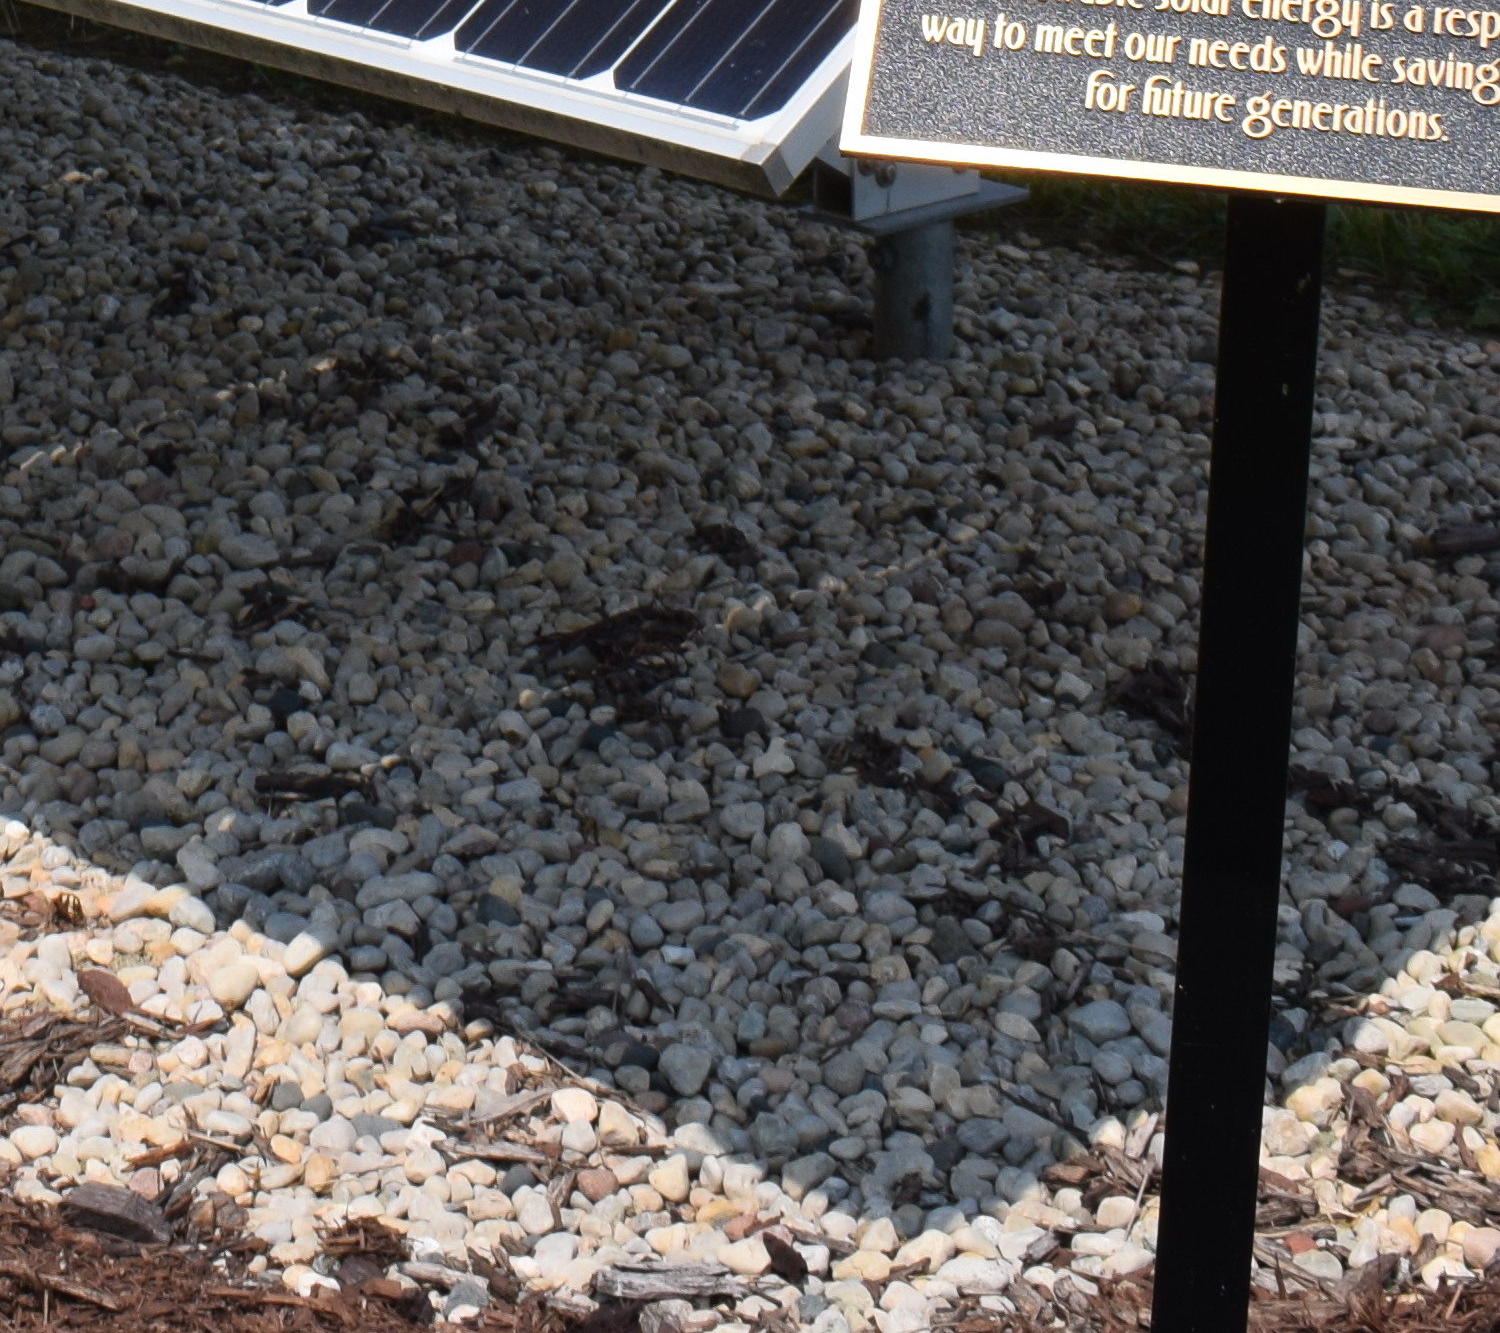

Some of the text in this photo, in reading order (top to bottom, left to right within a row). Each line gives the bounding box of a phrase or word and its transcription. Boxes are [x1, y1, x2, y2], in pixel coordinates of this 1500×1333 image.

[920, 13, 986, 57] way
[992, 12, 1026, 50] to
[1033, 21, 1118, 58] meet
[1123, 31, 1182, 63] our
[1188, 35, 1287, 73] needs
[1296, 40, 1383, 81] while
[1403, 4, 1424, 32] a
[1084, 67, 1451, 143] for future generations.
